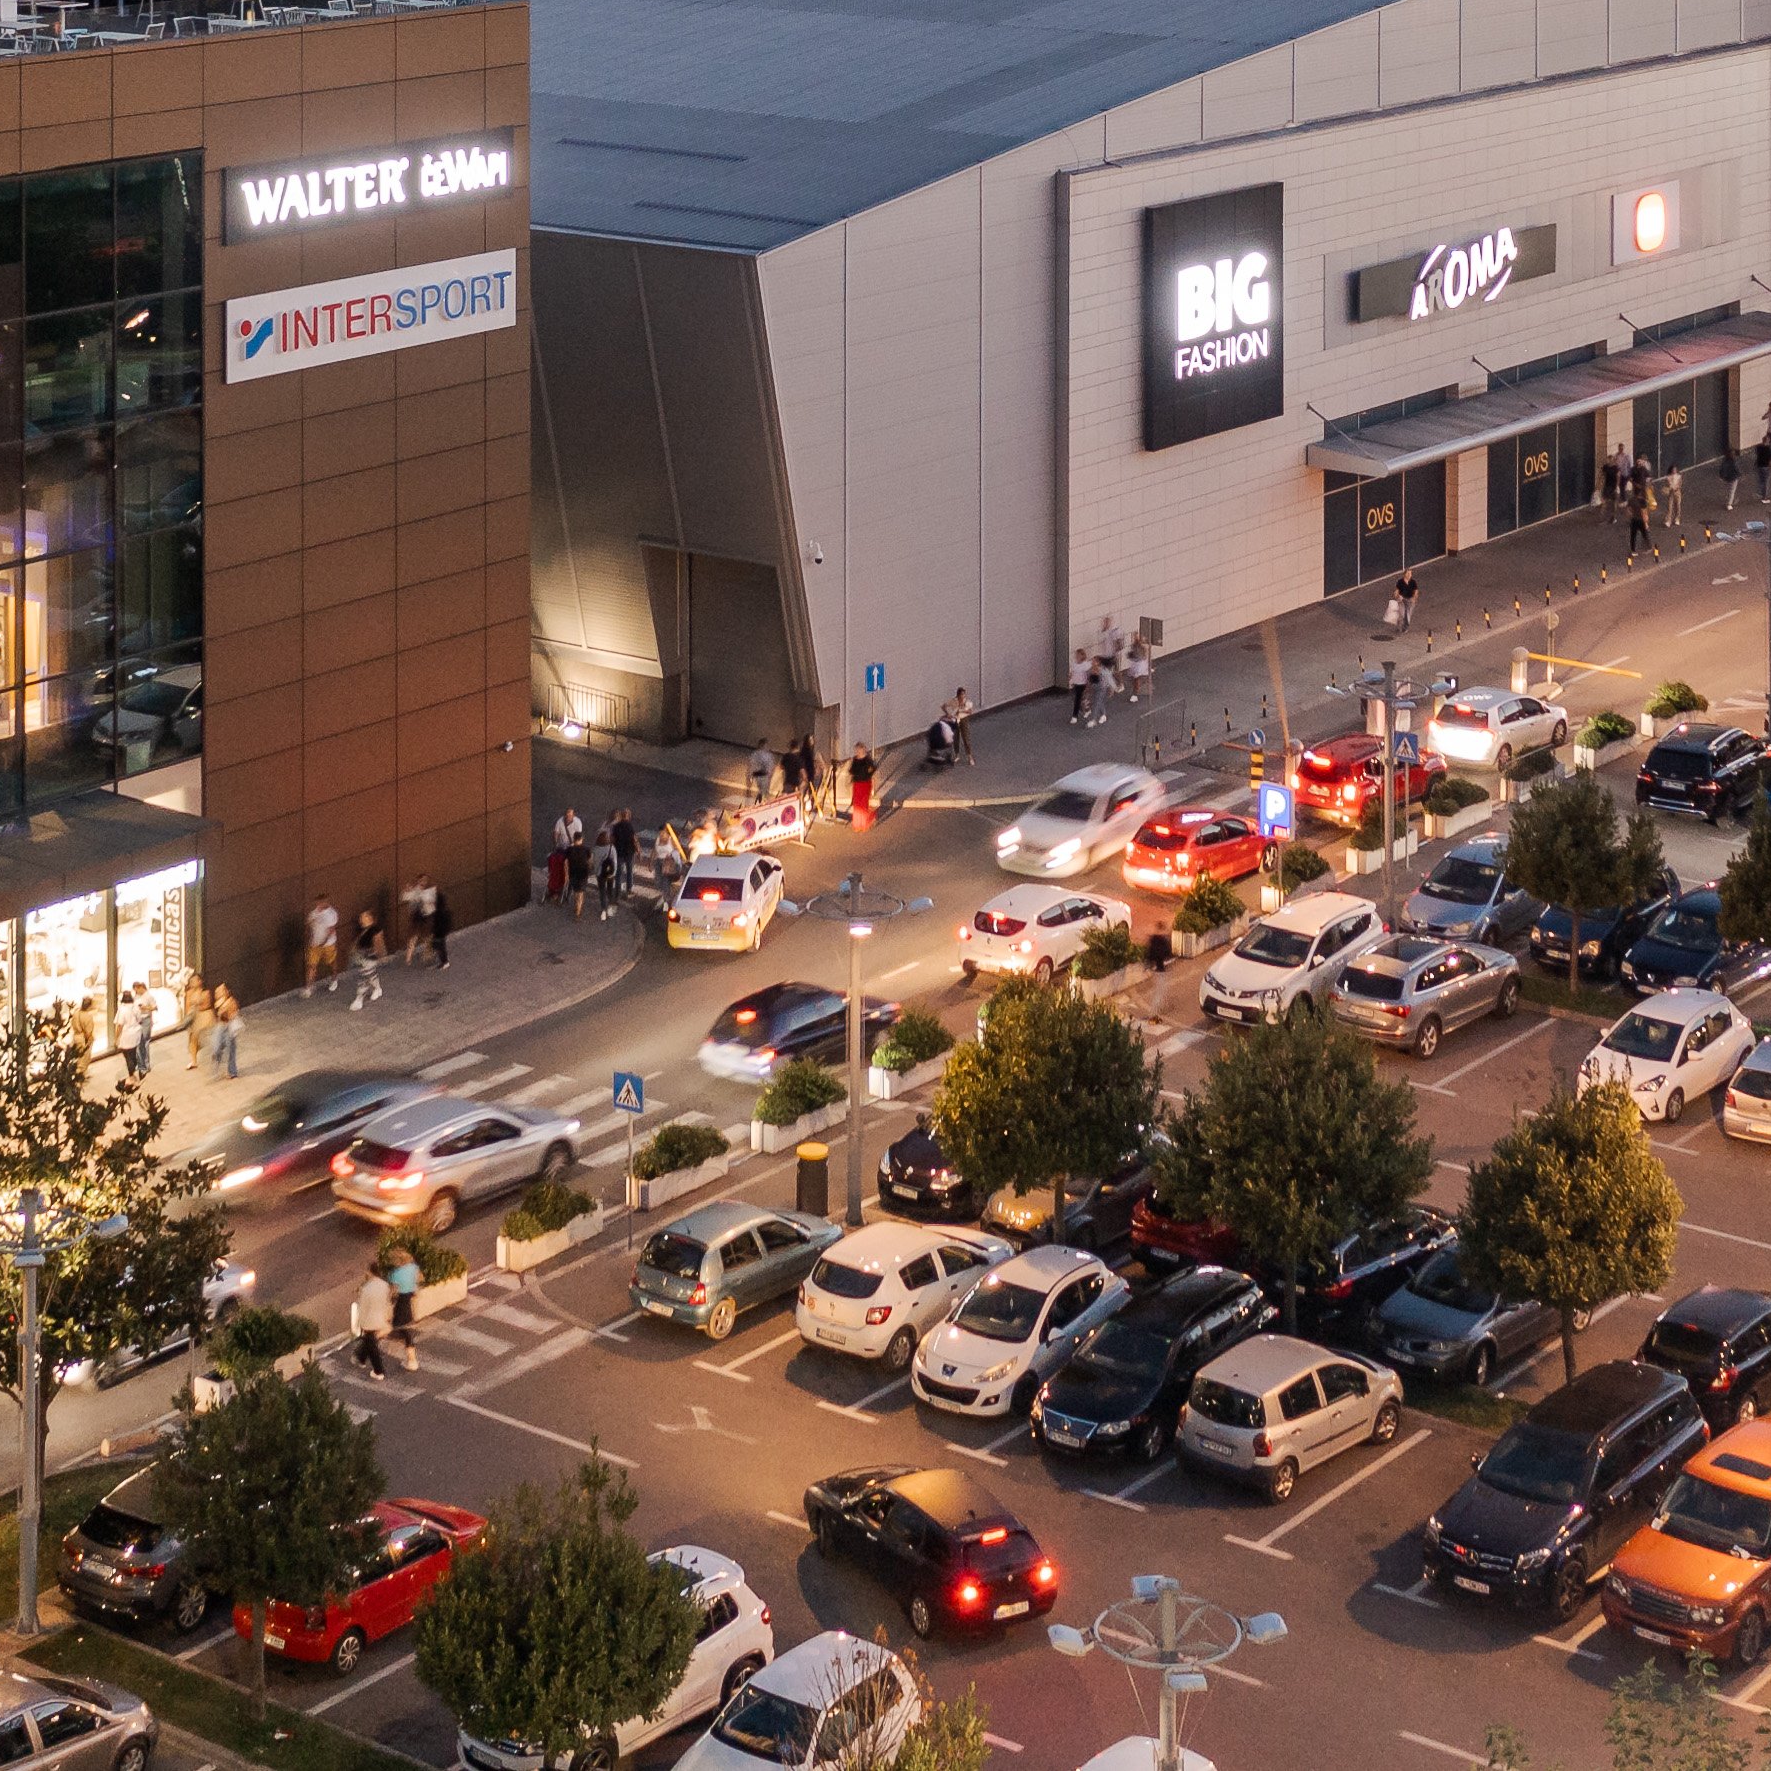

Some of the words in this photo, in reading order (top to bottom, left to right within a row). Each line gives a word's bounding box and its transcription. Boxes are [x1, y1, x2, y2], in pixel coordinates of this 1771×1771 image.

[241, 156, 408, 226] WALTER
[1177, 251, 1270, 341] BIG
[1411, 227, 1518, 321] AROMA
[281, 271, 512, 353] INTERSPORT
[1176, 328, 1269, 380] FASHION
[1665, 405, 1687, 429] OVS
[1525, 452, 1549, 477] OVS
[1367, 502, 1395, 530] OVS
[1266, 789, 1286, 821] P
